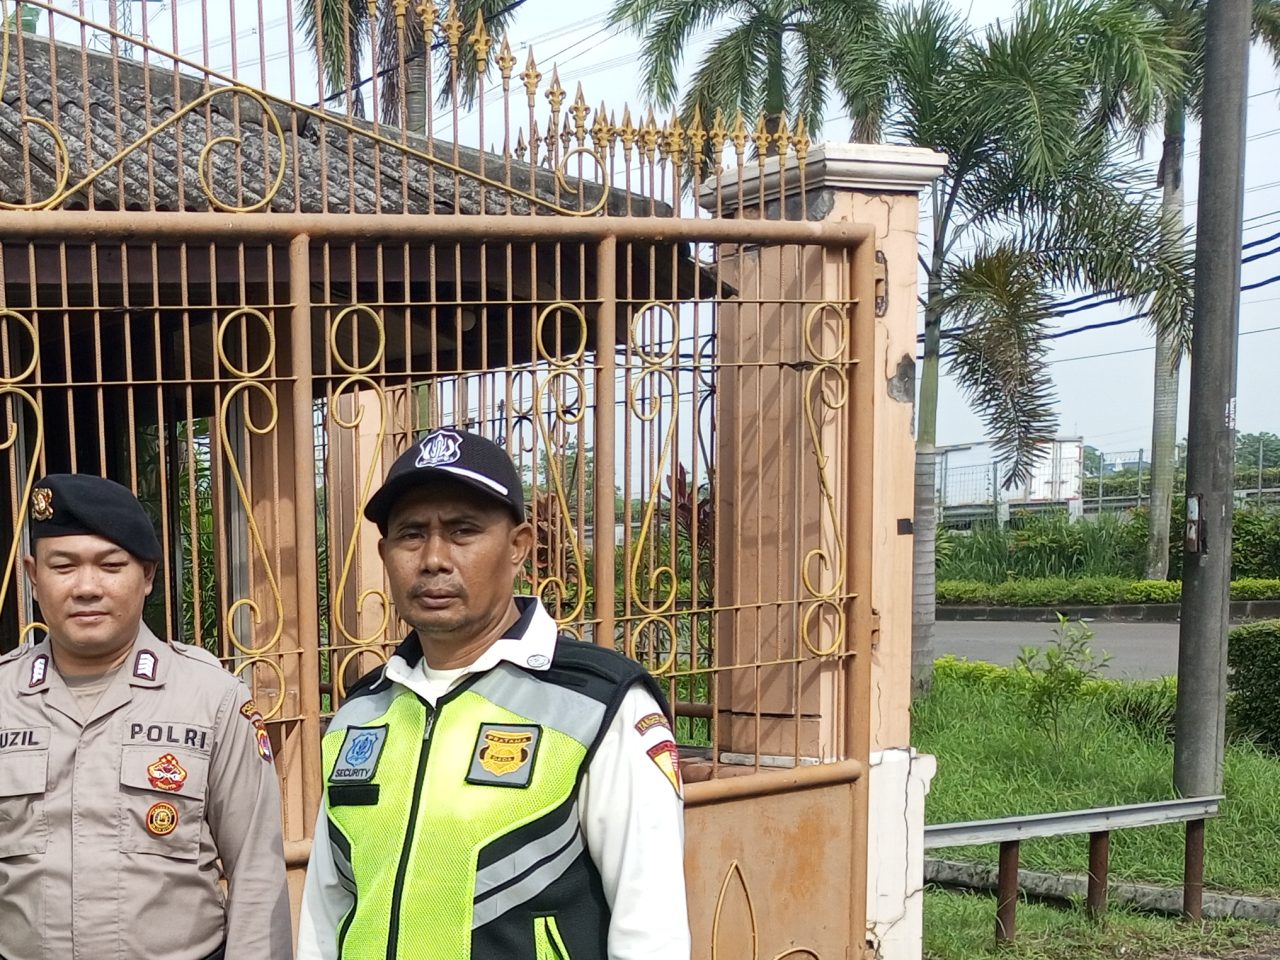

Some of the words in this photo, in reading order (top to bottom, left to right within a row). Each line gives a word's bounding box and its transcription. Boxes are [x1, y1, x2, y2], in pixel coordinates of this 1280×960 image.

[130, 723, 207, 749] POLRI
[488, 735, 528, 744] PRATAMA
[335, 768, 370, 778] SECURITY
